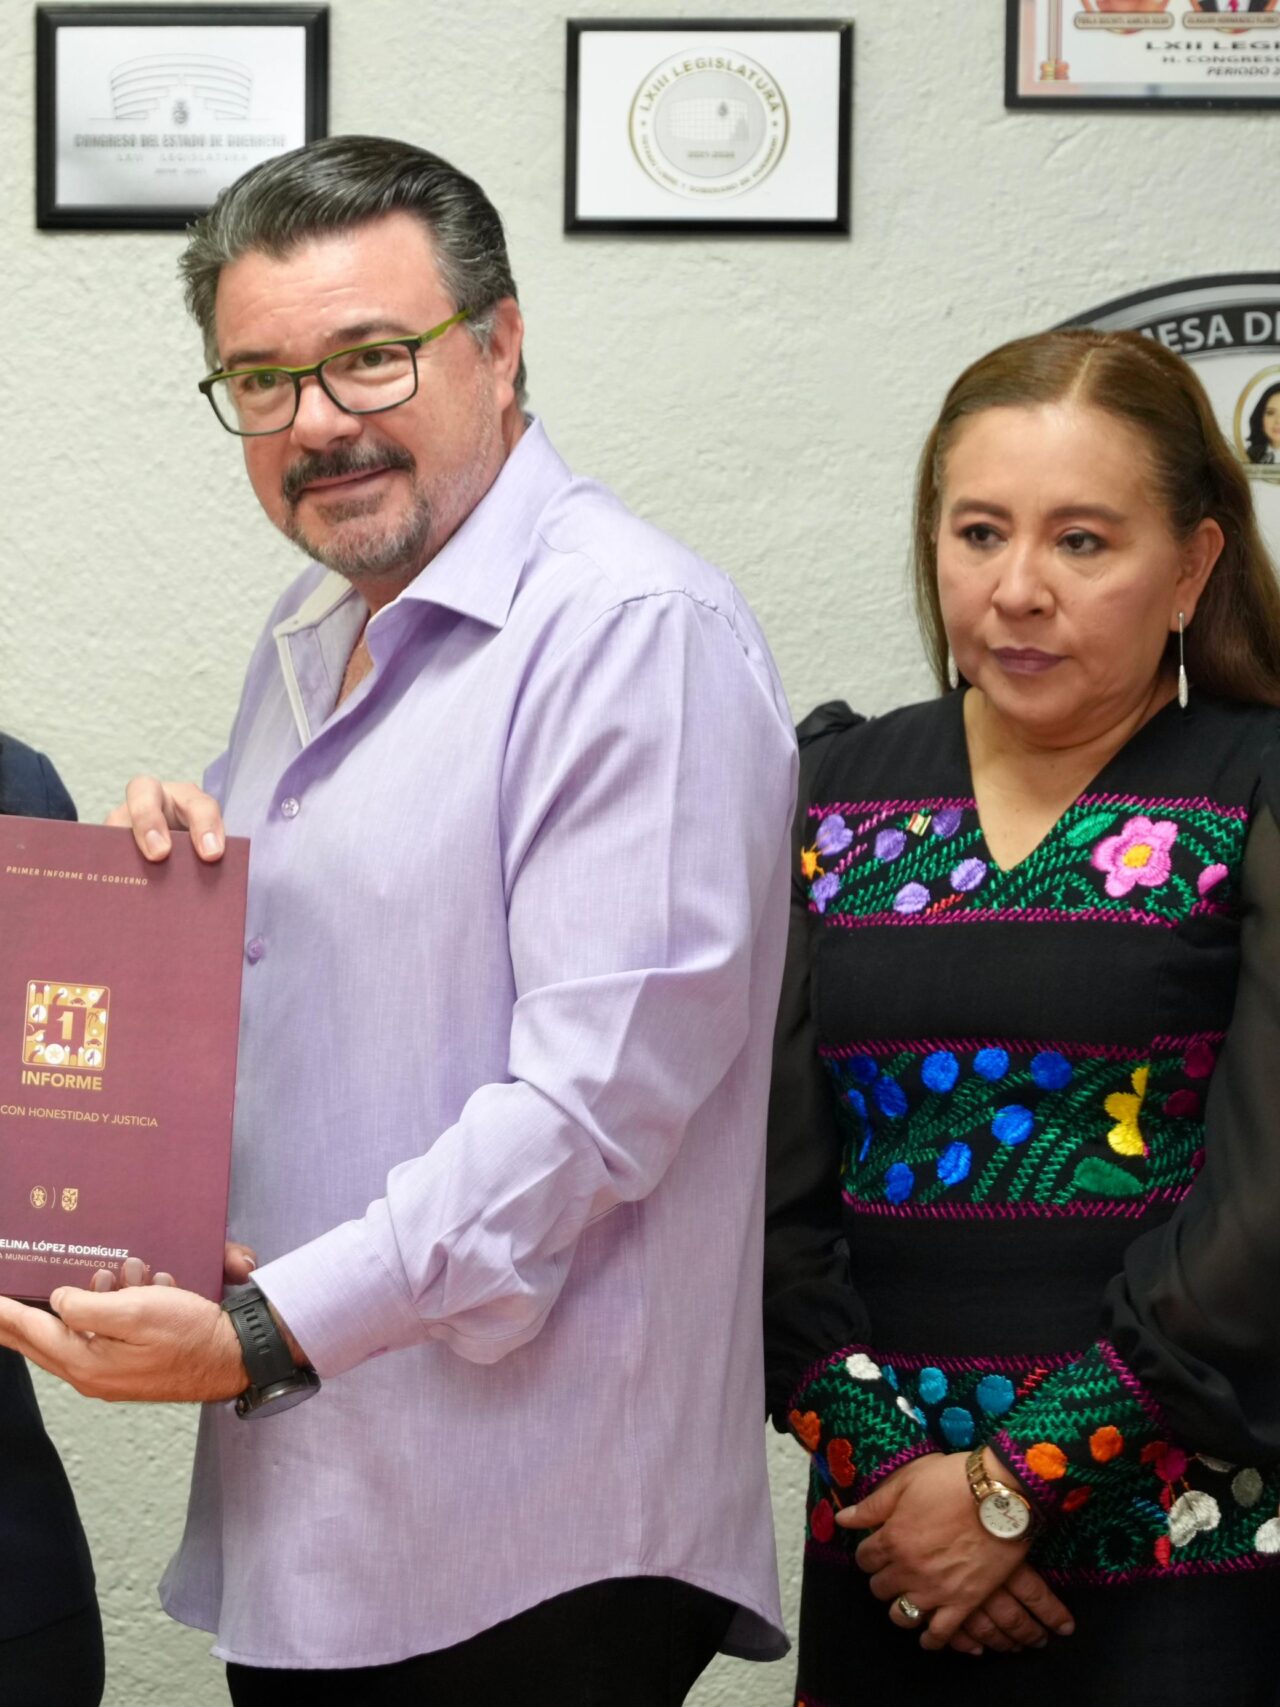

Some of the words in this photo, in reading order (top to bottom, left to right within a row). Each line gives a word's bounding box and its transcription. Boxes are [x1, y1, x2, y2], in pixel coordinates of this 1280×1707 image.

[1146, 41, 1202, 50] LXII
[639, 74, 670, 112] LXIII
[672, 57, 781, 112] LEGISLATURA
[74, 134, 137, 148] CONGRESO
[163, 134, 205, 148] ESTADO
[6, 865, 40, 876] PRIMER
[43, 869, 83, 880] INFORME
[87, 873, 98, 881] DE
[102, 875, 148, 886] GOBIERNO
[56, 1011, 74, 1040] 1
[21, 1070, 103, 1091] INFORME
[0, 1104, 26, 1117] CON
[28, 1107, 100, 1123] HONESTIDAD
[102, 1114, 110, 1123] Y
[111, 1114, 158, 1127] JUSTICIA
[32, 1239, 66, 1253] LÓPEZ
[68, 1243, 129, 1258] RODRÍGUEZ
[5, 1253, 48, 1263] MUNICIPAL
[50, 1256, 61, 1264] DE
[63, 1257, 106, 1268] ACAPULCO
[108, 1261, 118, 1269] DE
